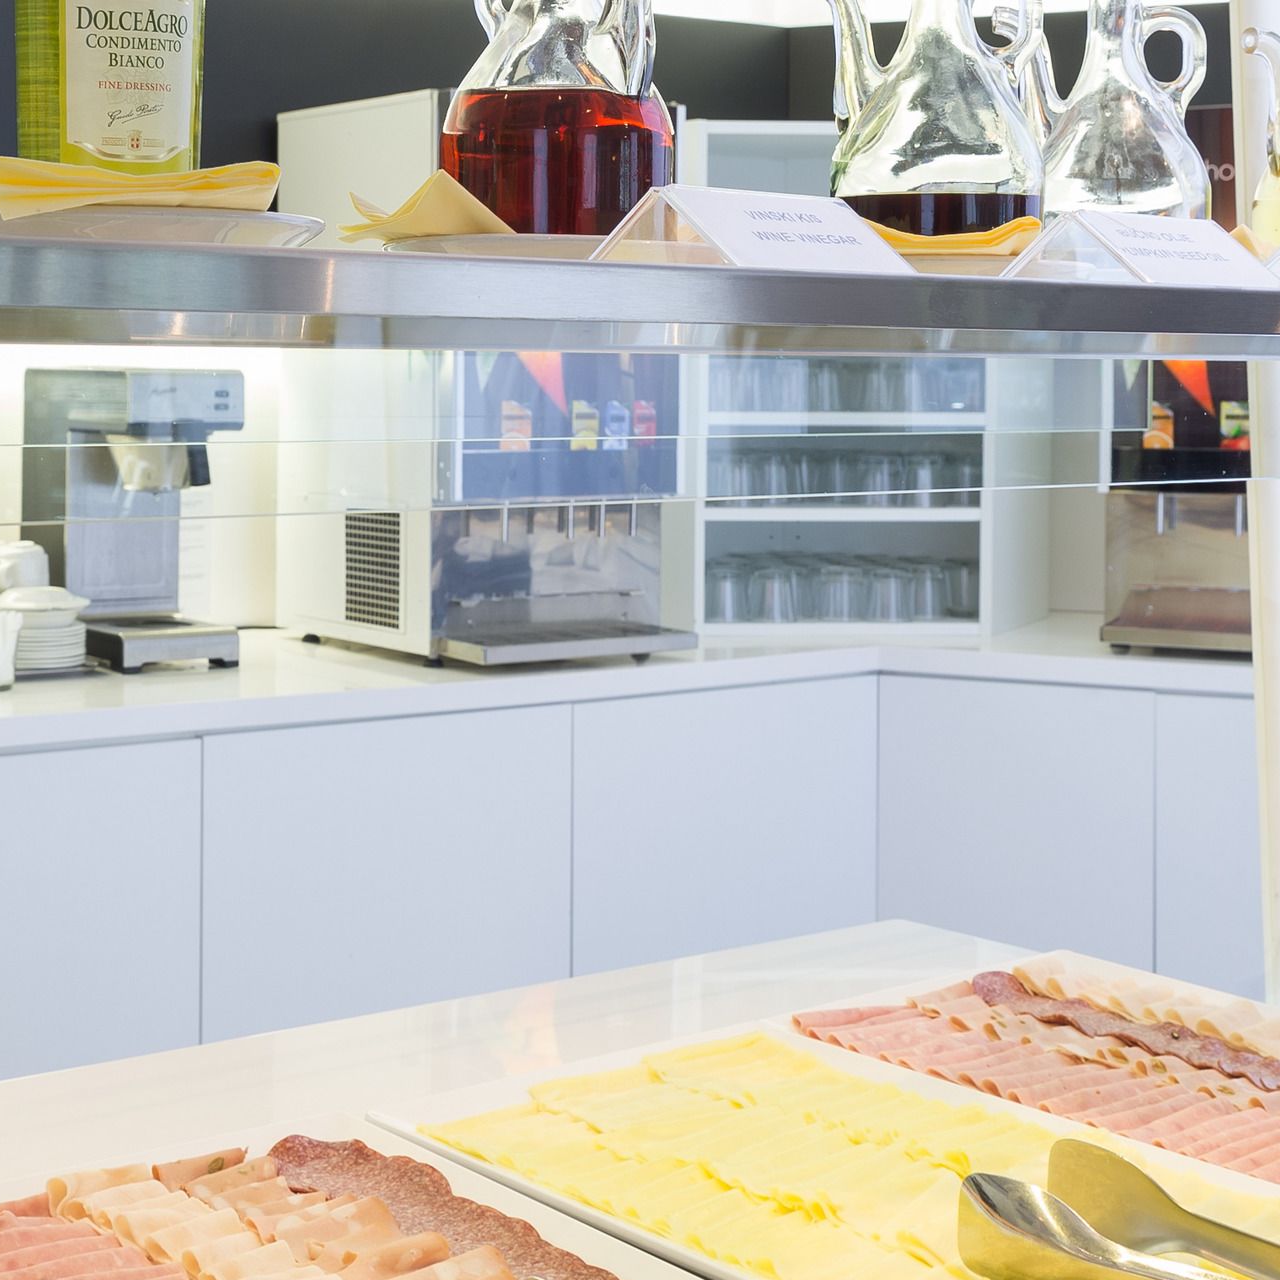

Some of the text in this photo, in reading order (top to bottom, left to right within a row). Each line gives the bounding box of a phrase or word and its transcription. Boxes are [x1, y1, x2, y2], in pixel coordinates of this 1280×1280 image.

[76, 6, 188, 38] DOLCEAGRO
[85, 33, 182, 53] CONDIMENTO
[108, 52, 165, 69] BIANCO
[98, 80, 172, 92] FINE DRESSING
[743, 209, 824, 224] VINSKI KIS
[751, 230, 863, 246] WINE VINEGAR
